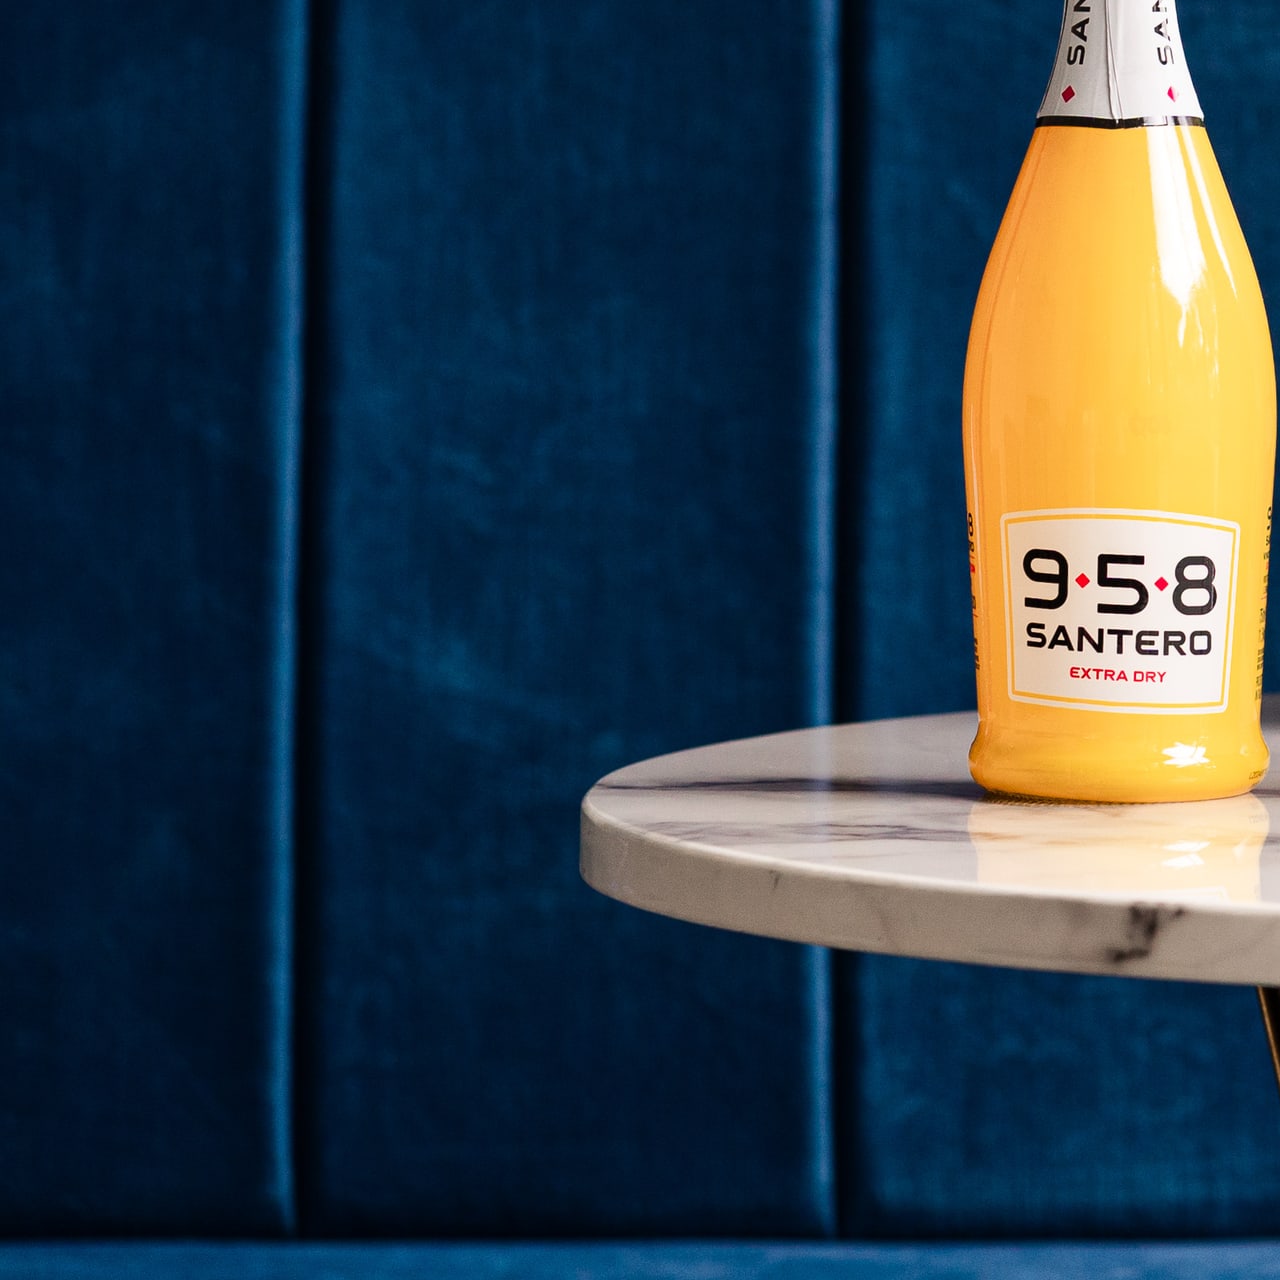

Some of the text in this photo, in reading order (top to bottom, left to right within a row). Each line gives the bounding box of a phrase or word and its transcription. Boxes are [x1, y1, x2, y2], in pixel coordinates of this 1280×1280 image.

[1026, 622, 1212, 656] SANTERO
[1069, 666, 1167, 683] EXTRA DRY
